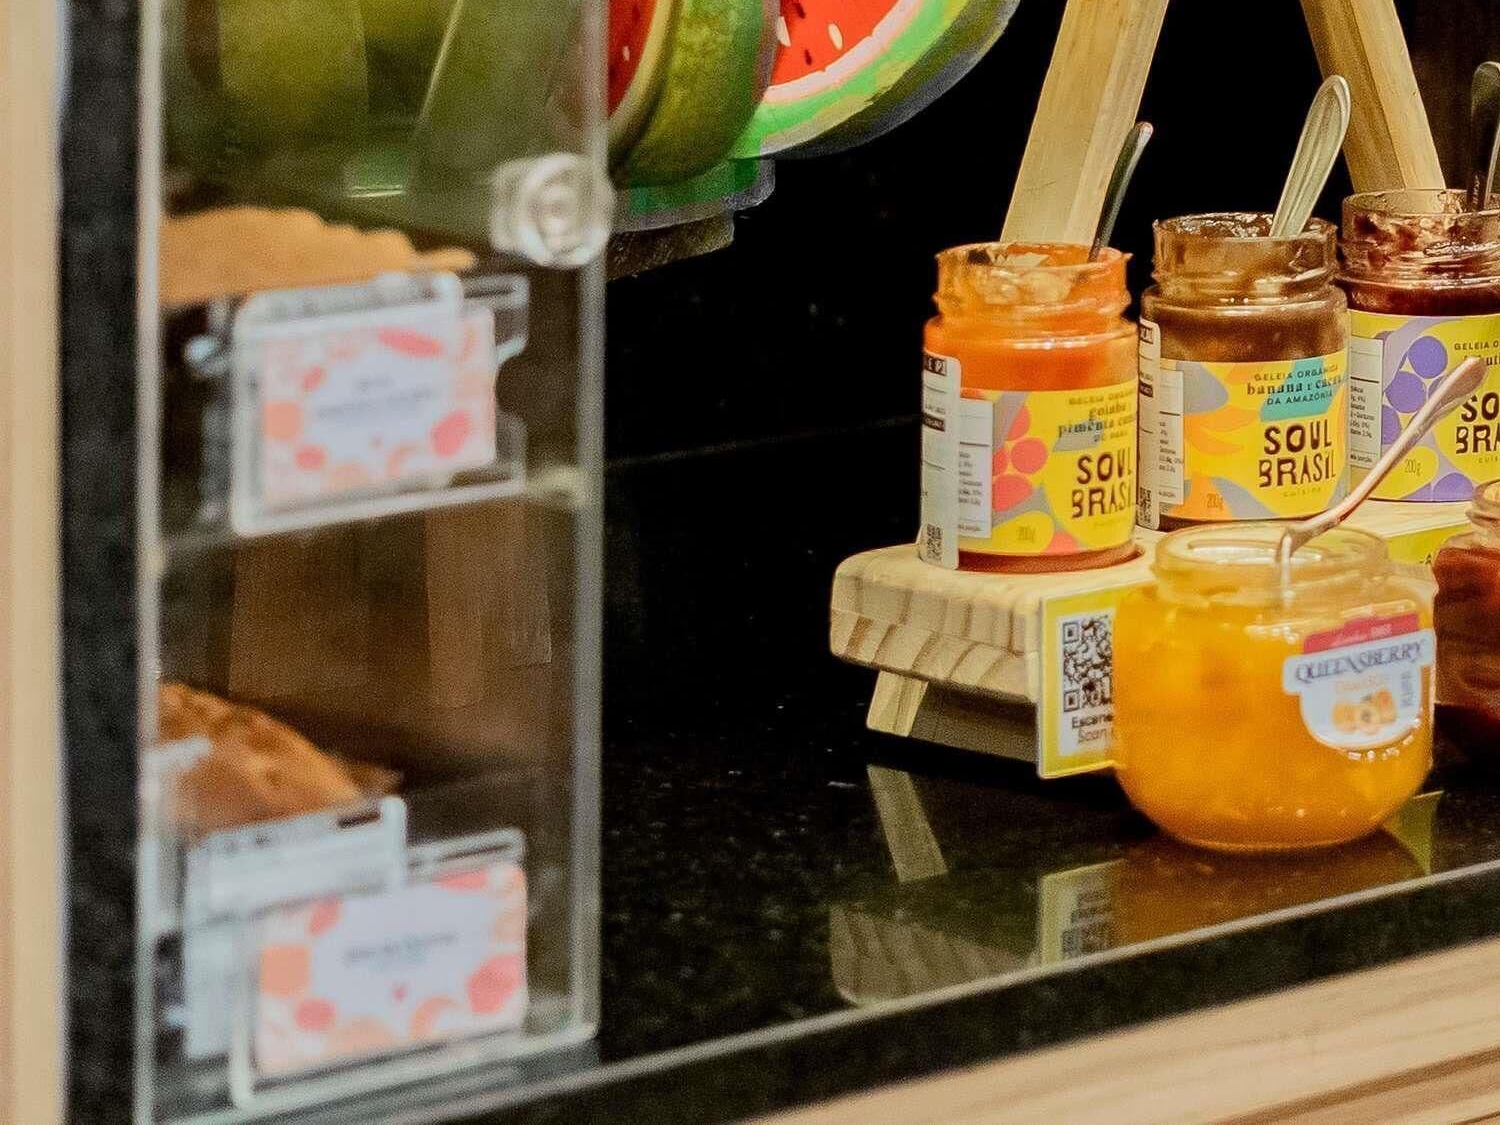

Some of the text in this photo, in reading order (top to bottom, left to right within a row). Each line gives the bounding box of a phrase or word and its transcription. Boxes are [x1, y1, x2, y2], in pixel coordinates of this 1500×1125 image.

[1454, 341, 1489, 351] GELEIA
[1247, 382, 1303, 396] banana
[1267, 396, 1281, 405] DA
[1264, 419, 1332, 455] SOUL
[1077, 447, 1132, 485] SOUL
[1295, 638, 1427, 684] QUEENSBERRY
